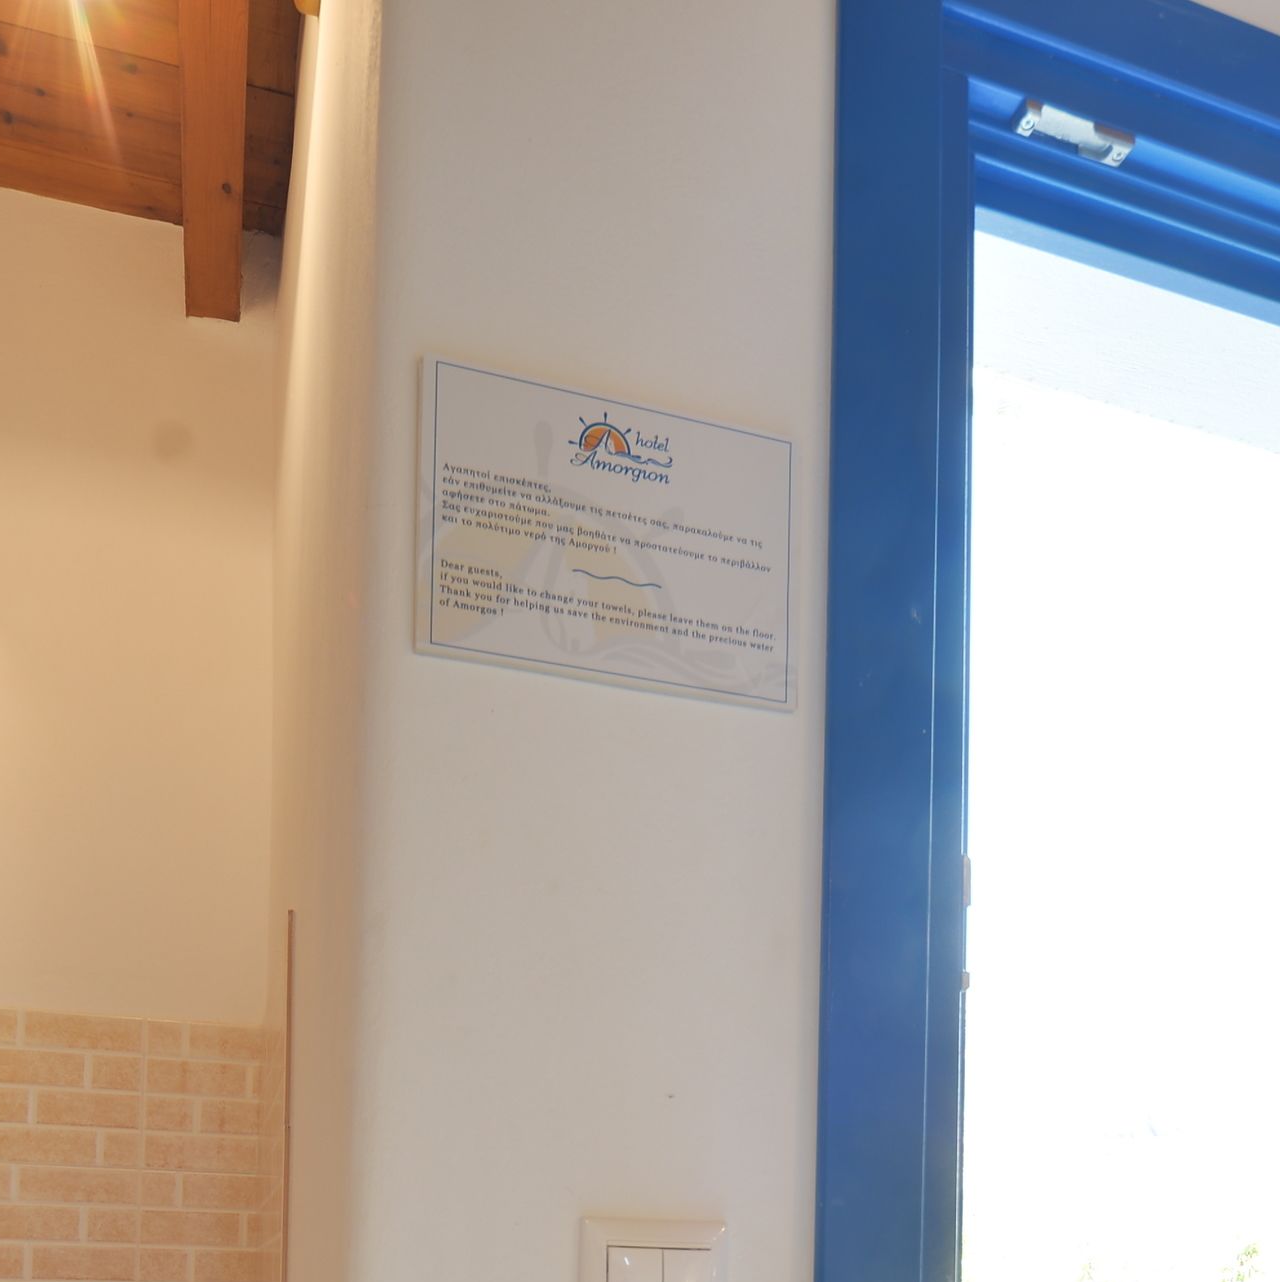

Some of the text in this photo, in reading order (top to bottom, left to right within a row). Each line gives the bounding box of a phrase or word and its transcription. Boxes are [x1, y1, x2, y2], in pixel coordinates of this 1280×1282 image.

[635, 431, 670, 452] hotel
[443, 463, 491, 480] Αγαπητοί
[442, 489, 485, 503] αφήσετε
[488, 498, 506, 508] στο
[442, 476, 460, 486] εάν
[463, 481, 517, 498] επιθυμείτε
[520, 492, 532, 500] να
[535, 495, 587, 512] αλλάξουμε
[590, 506, 603, 516] τις
[605, 509, 647, 526] πετσέτες
[672, 523, 734, 543] παρακαλούμε
[737, 537, 748, 545] να
[750, 539, 763, 550] τις
[442, 514, 458, 524] και
[462, 517, 473, 527] το
[475, 520, 521, 536] πολύτιμο
[523, 531, 547, 542] νερό
[550, 536, 566, 546] της
[569, 537, 611, 554] Αμοργού
[442, 500, 772, 573] Σας ευχαριστούμε που μας βοηθάτε να προστατεύουμε το περιβάλλον
[440, 559, 503, 579] Dear guests,
[439, 596, 451, 607] of
[453, 601, 498, 616] Amorgos
[439, 584, 774, 652] Thank you for helping us save the environment and the precious water
[440, 571, 776, 641] if you would like to change your towels, please leave them on the floor.
